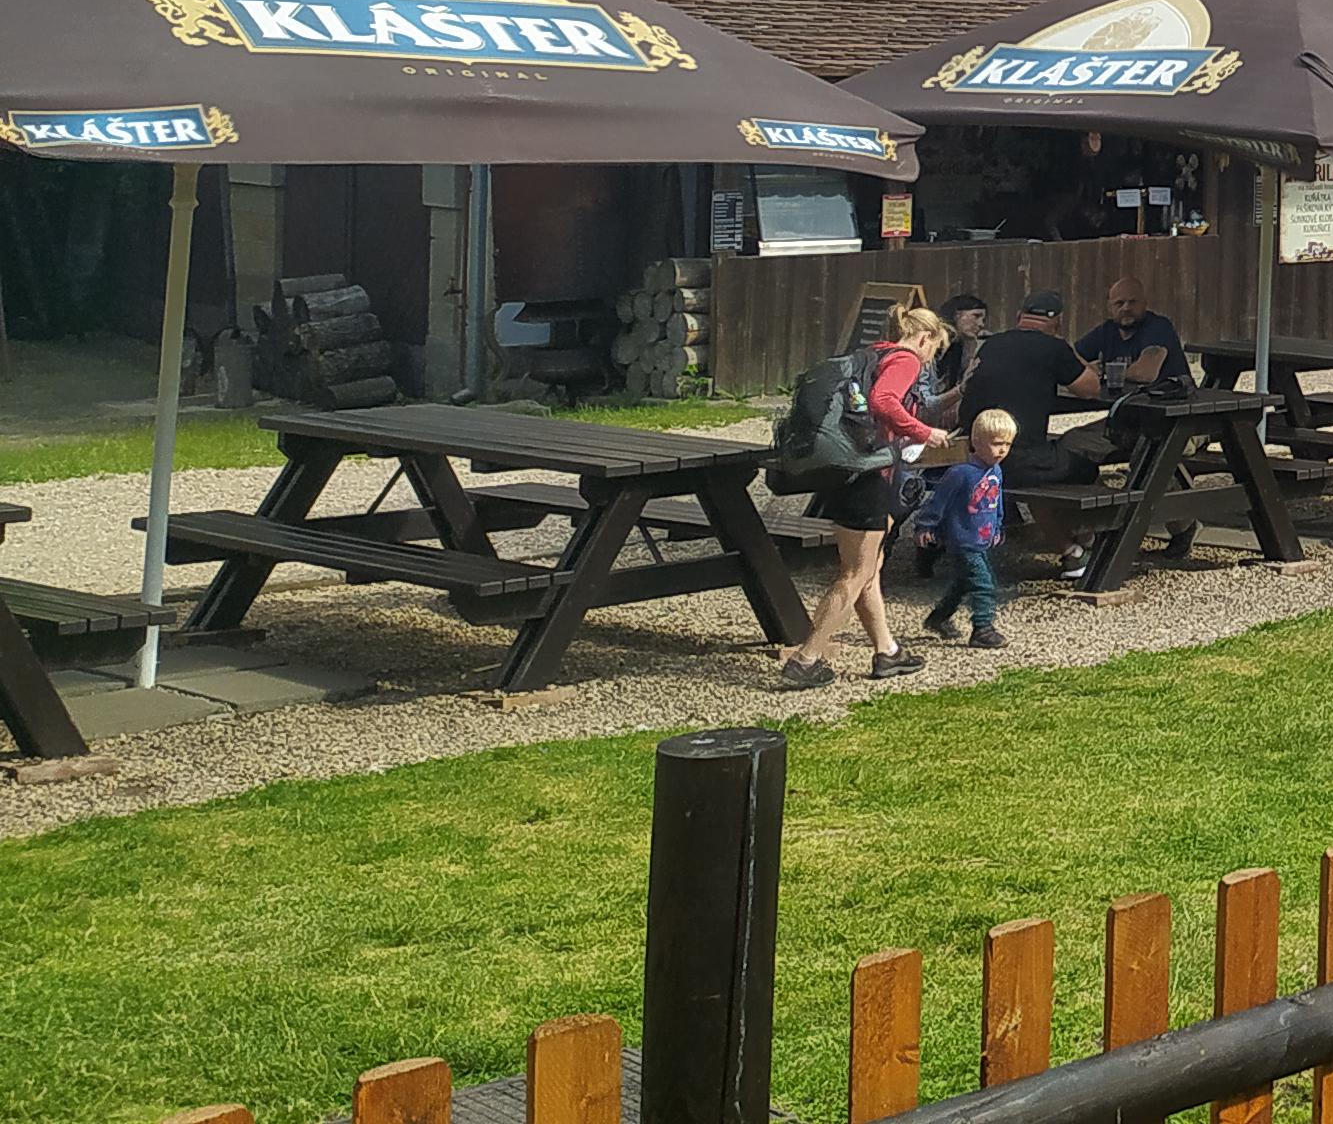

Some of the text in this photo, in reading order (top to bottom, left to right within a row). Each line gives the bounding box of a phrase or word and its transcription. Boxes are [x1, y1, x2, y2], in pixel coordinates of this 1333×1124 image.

[237, 0, 635, 60] KLÁŠTER
[402, 66, 548, 81] ORIGINAL
[967, 56, 1188, 87] KLÁŠTER
[763, 127, 883, 152] KLÁŠTER
